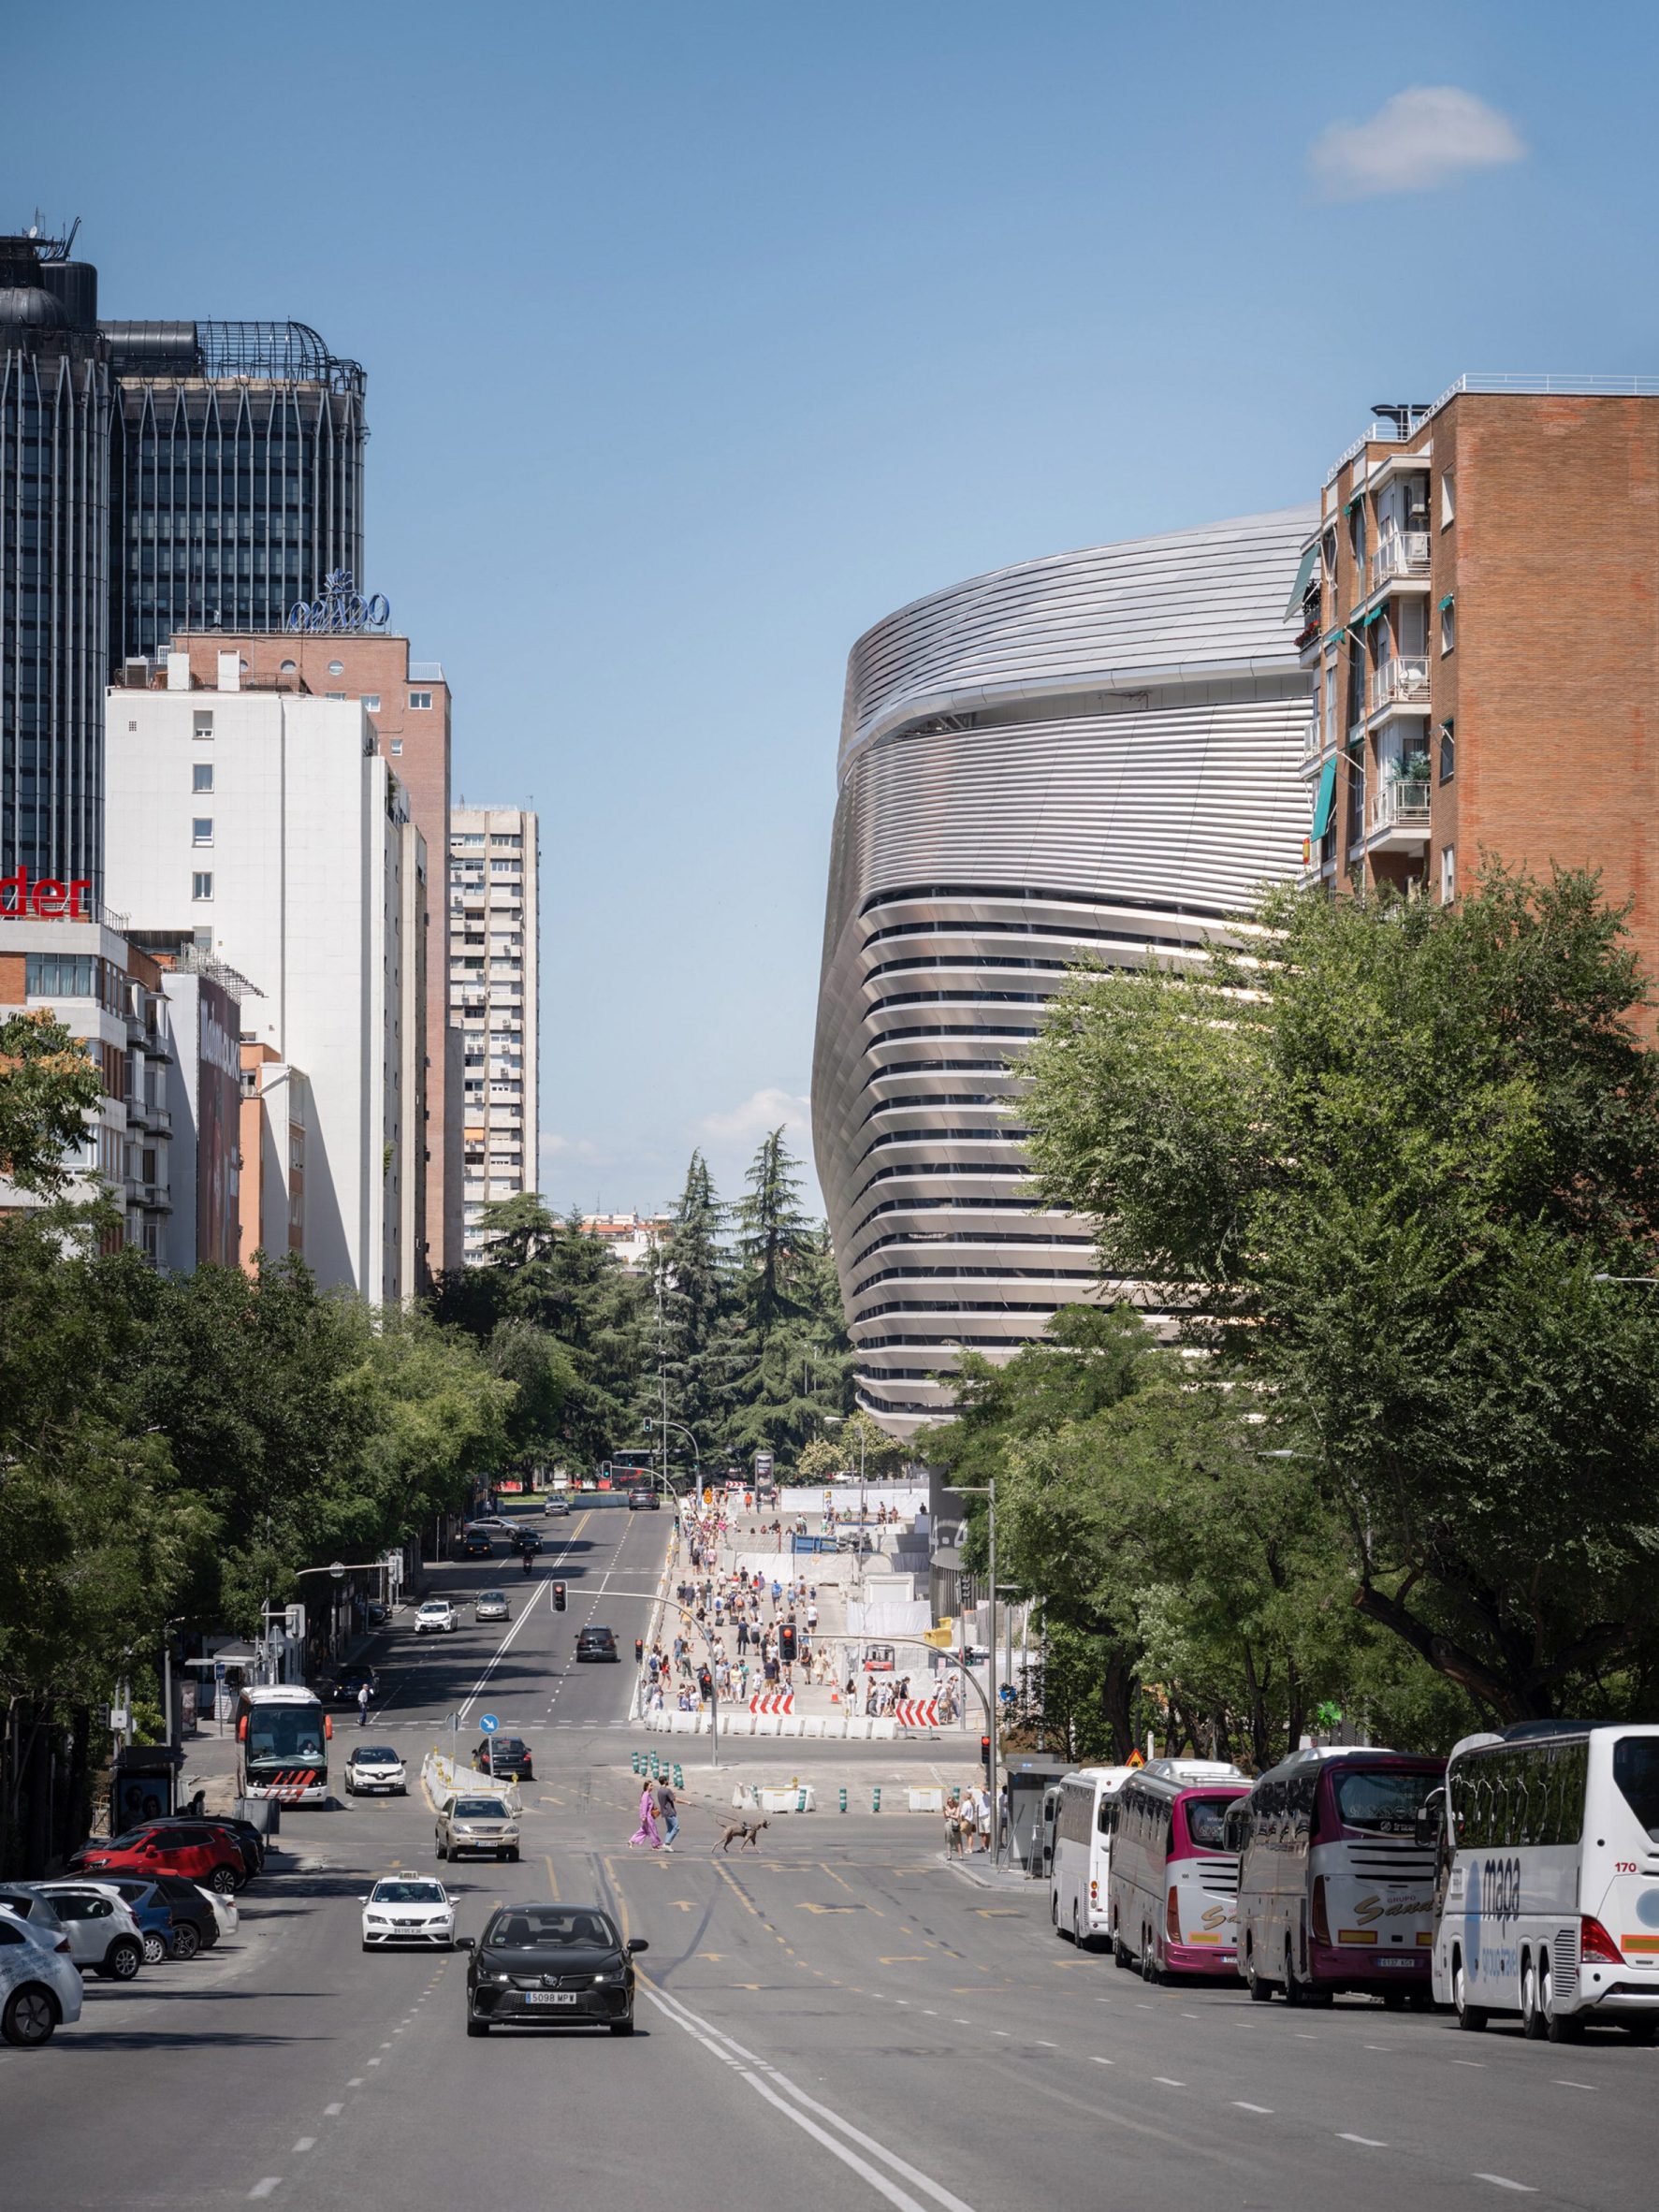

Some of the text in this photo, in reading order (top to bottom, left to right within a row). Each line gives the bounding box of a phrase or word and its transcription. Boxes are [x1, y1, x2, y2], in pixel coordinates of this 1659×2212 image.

[0, 865, 91, 918] der
[1615, 1862, 1637, 1872] 170
[1387, 1895, 1416, 1903] GRUPO
[1482, 1857, 1521, 1940] mapa
[532, 1993, 555, 2002] 5098
